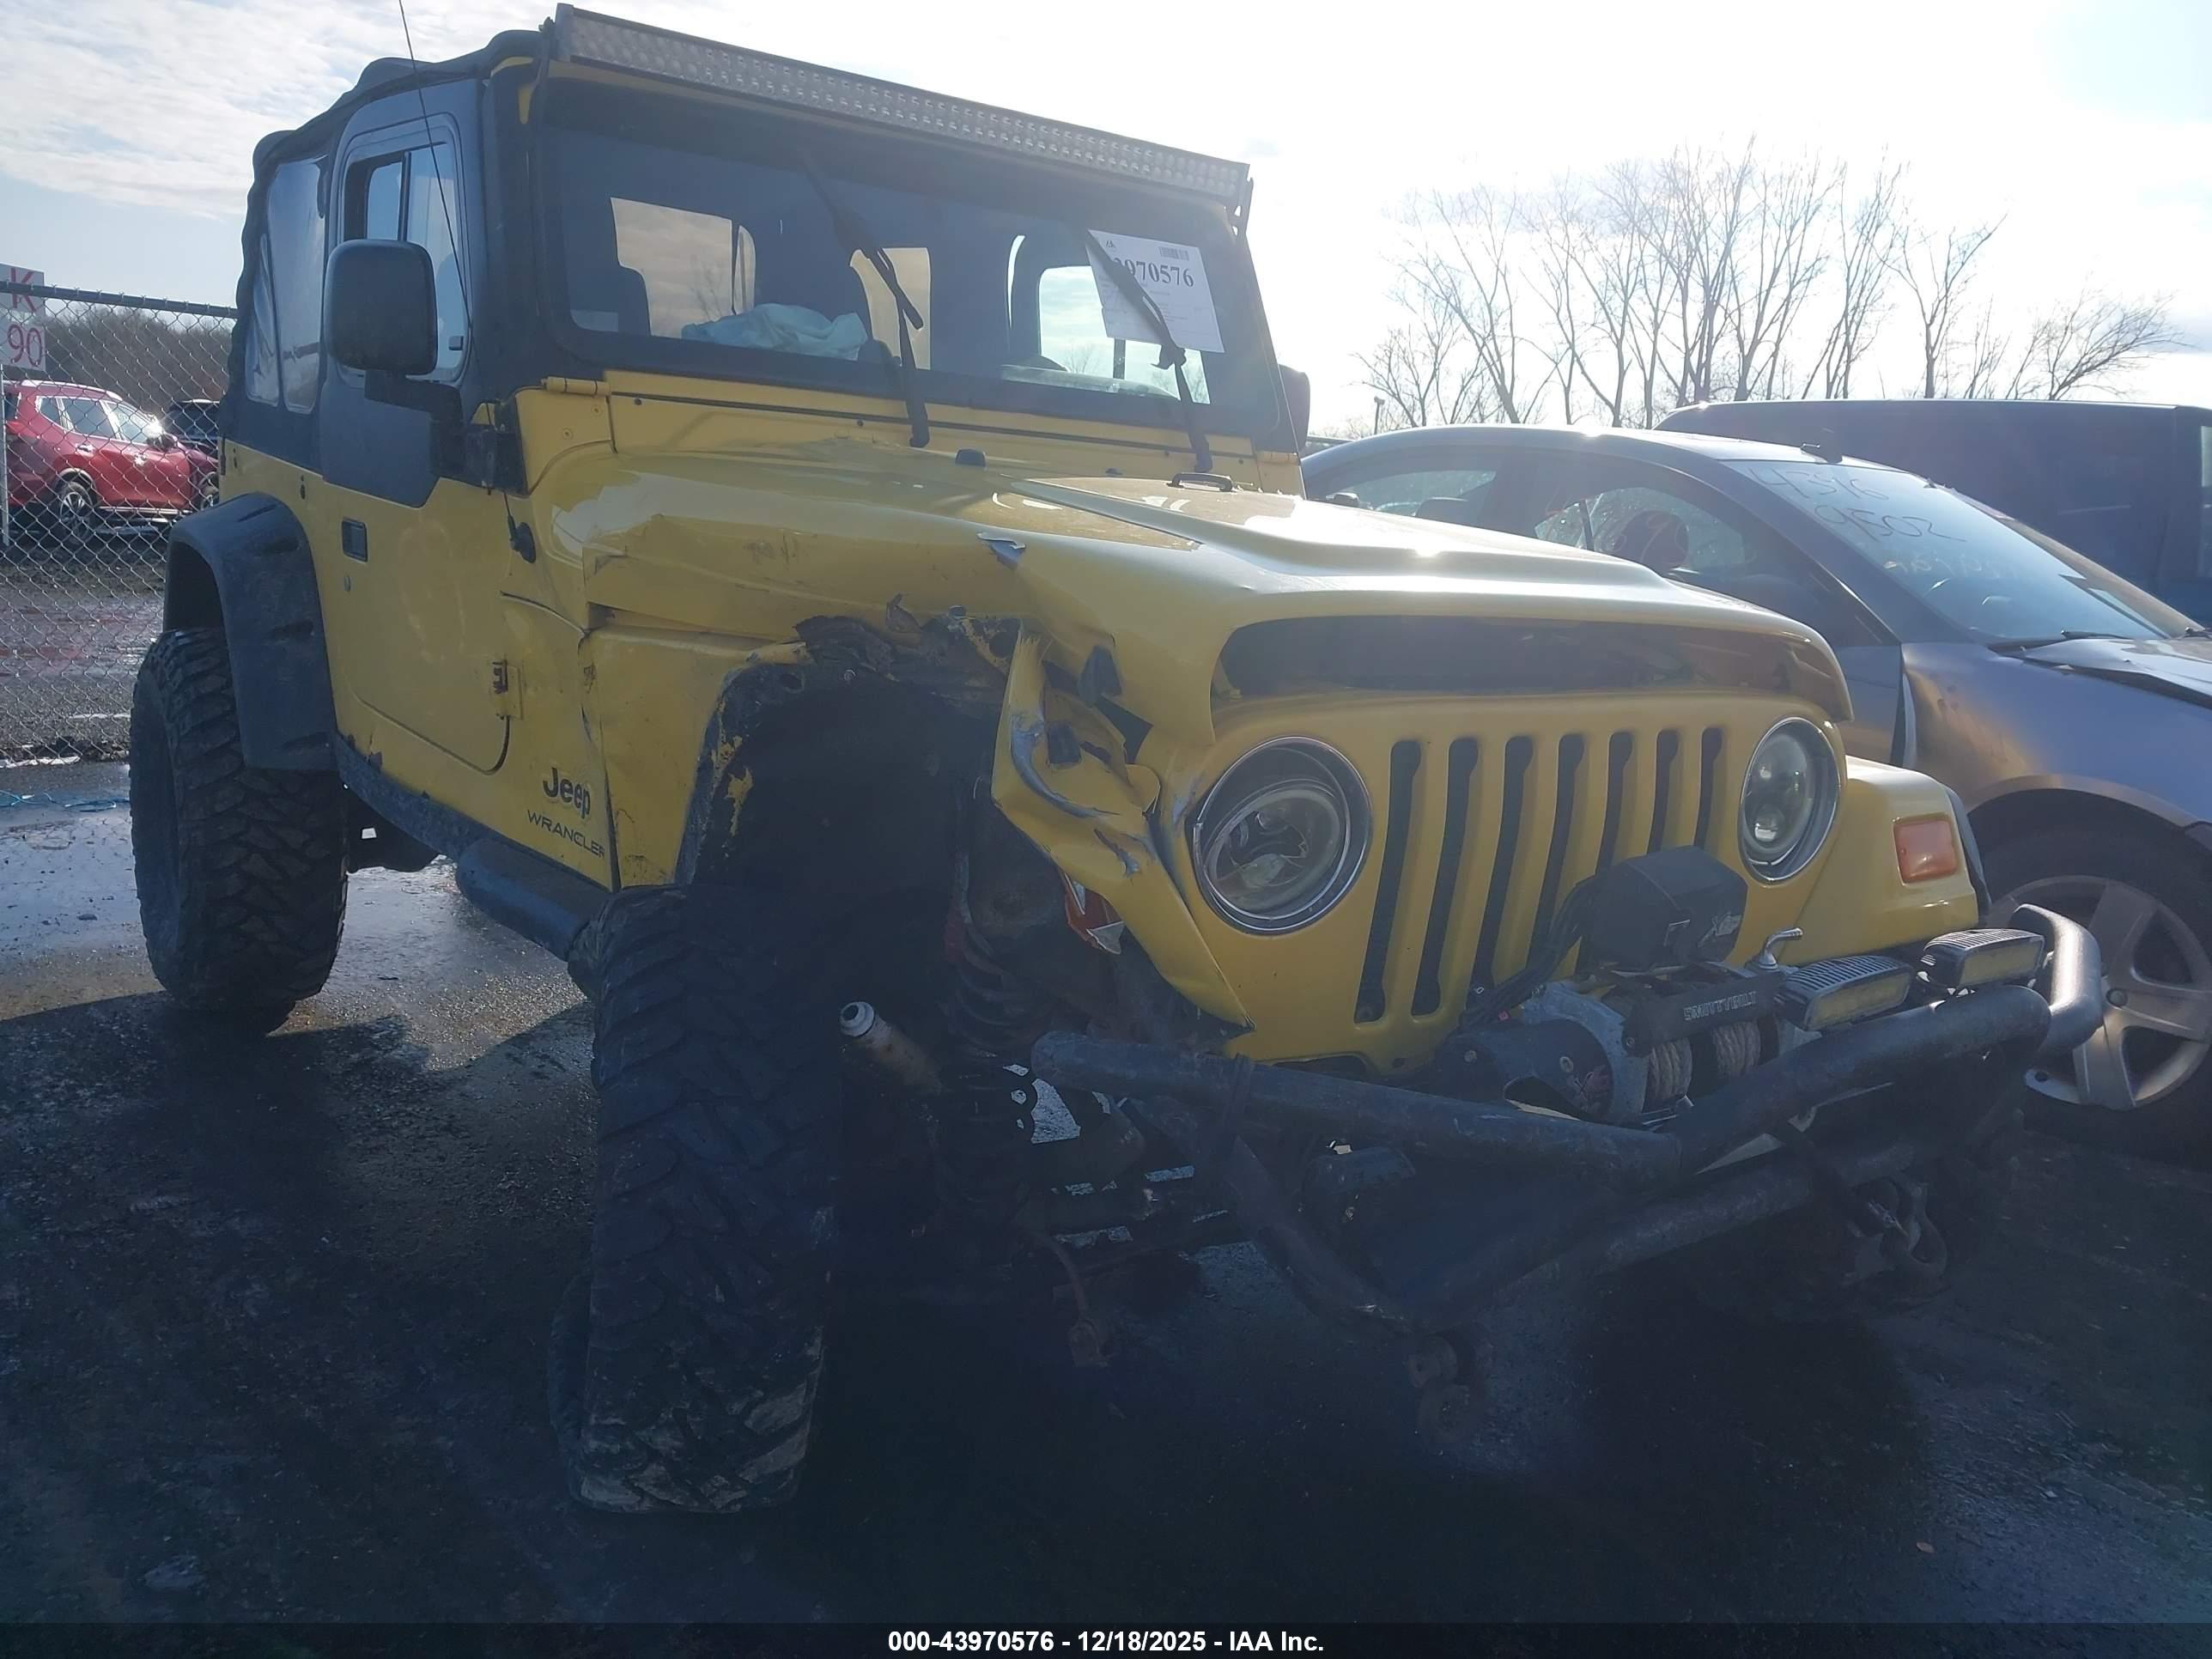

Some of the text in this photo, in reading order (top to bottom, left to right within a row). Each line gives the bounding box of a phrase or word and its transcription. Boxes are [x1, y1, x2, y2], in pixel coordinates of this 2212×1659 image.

[10, 267, 37, 313] K
[7, 324, 43, 367] 90
[542, 767, 591, 819] Jeep
[526, 809, 605, 859] WRANGLER
